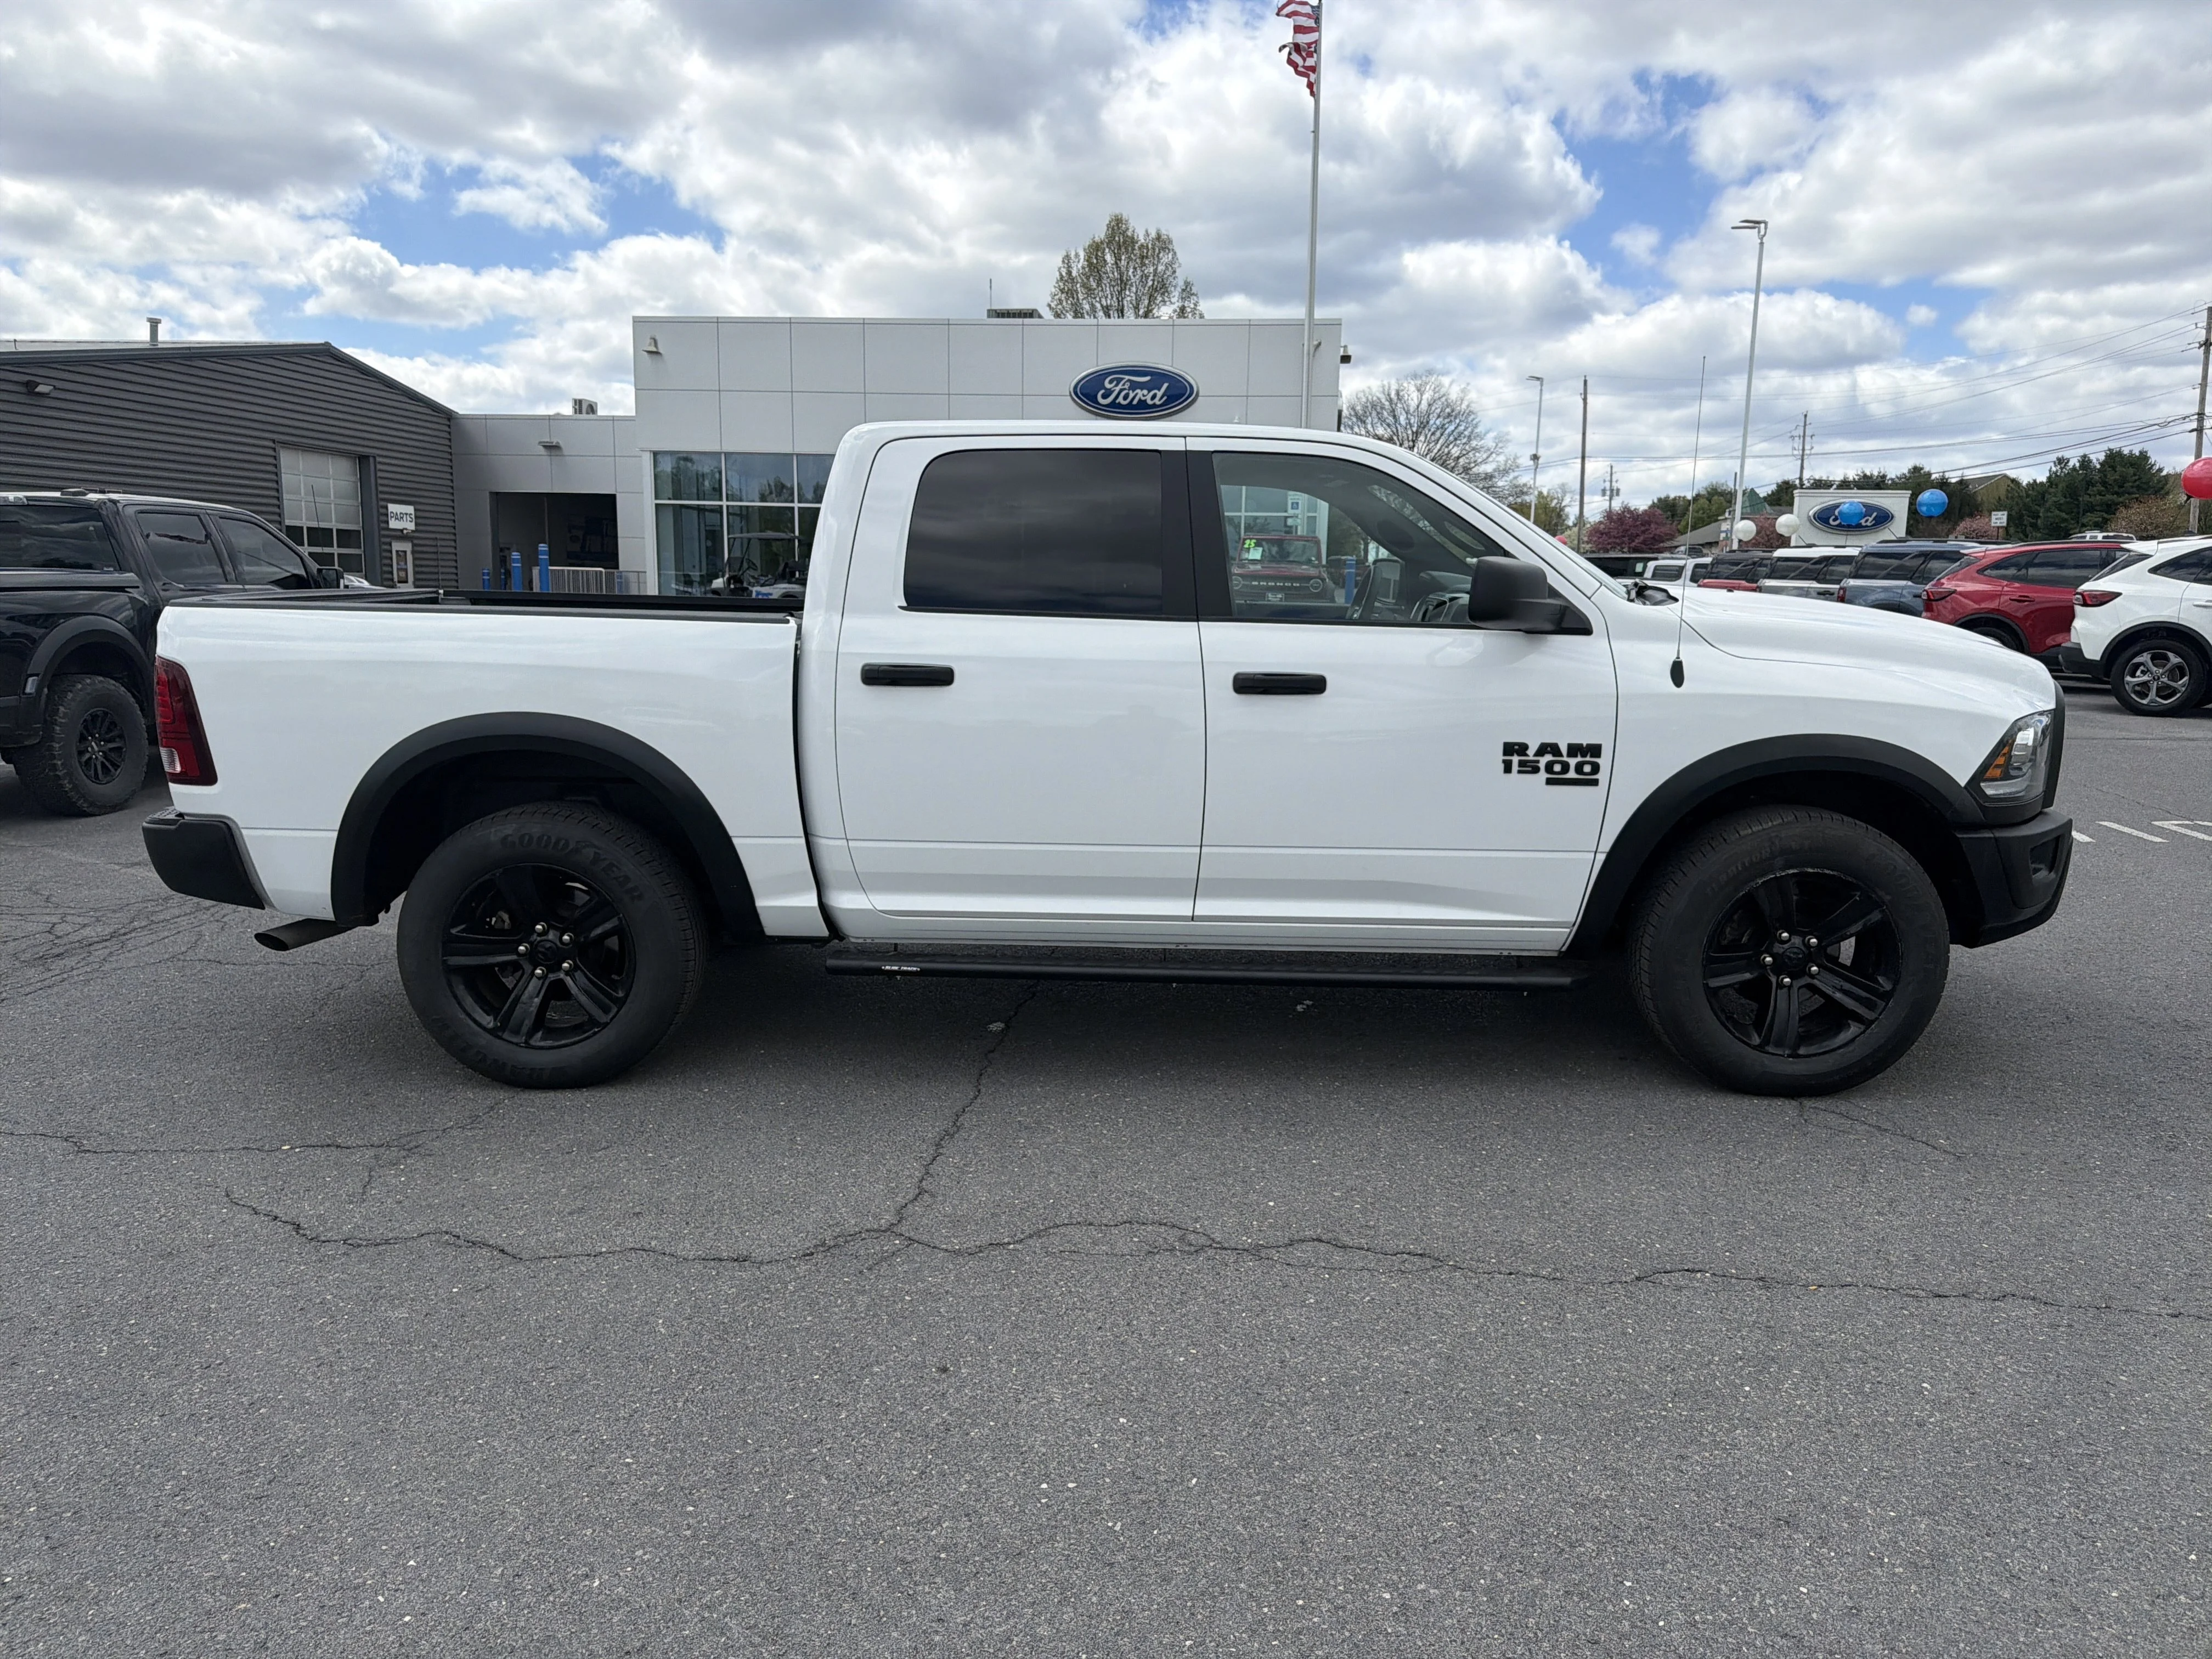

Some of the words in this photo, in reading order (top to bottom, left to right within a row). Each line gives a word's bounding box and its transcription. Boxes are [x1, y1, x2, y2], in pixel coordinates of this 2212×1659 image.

[1097, 375, 1169, 405] Ford
[390, 511, 414, 523] PARTS
[1243, 539, 1256, 548] 25
[1502, 741, 1602, 759] RAM
[1502, 759, 1601, 776] 1500
